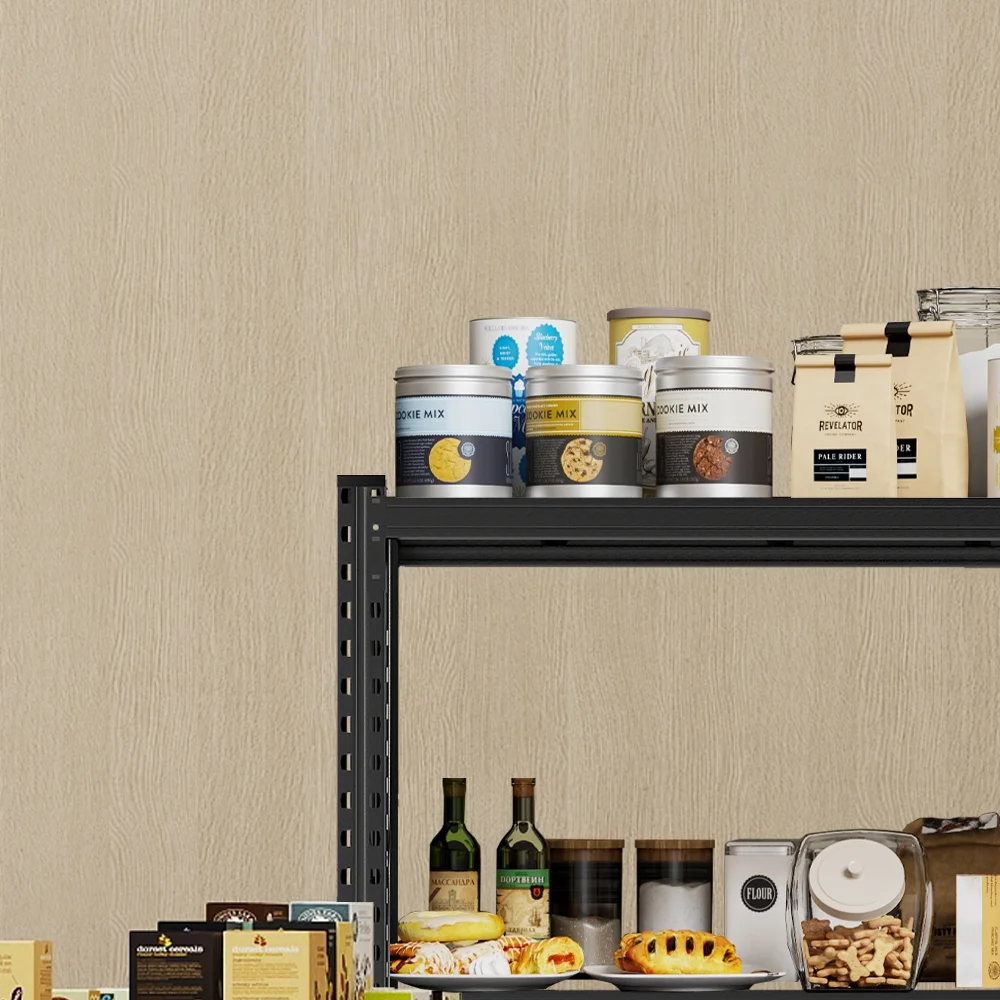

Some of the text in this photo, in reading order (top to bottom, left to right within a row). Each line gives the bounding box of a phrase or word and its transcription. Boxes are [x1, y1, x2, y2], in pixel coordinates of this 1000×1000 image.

[687, 404, 708, 413] MIX
[424, 410, 444, 418] MIX
[556, 410, 576, 418] MIX
[819, 420, 862, 431] REVELATOR
[432, 878, 475, 886] МАССАНДРА
[746, 887, 772, 900] FLOUR
